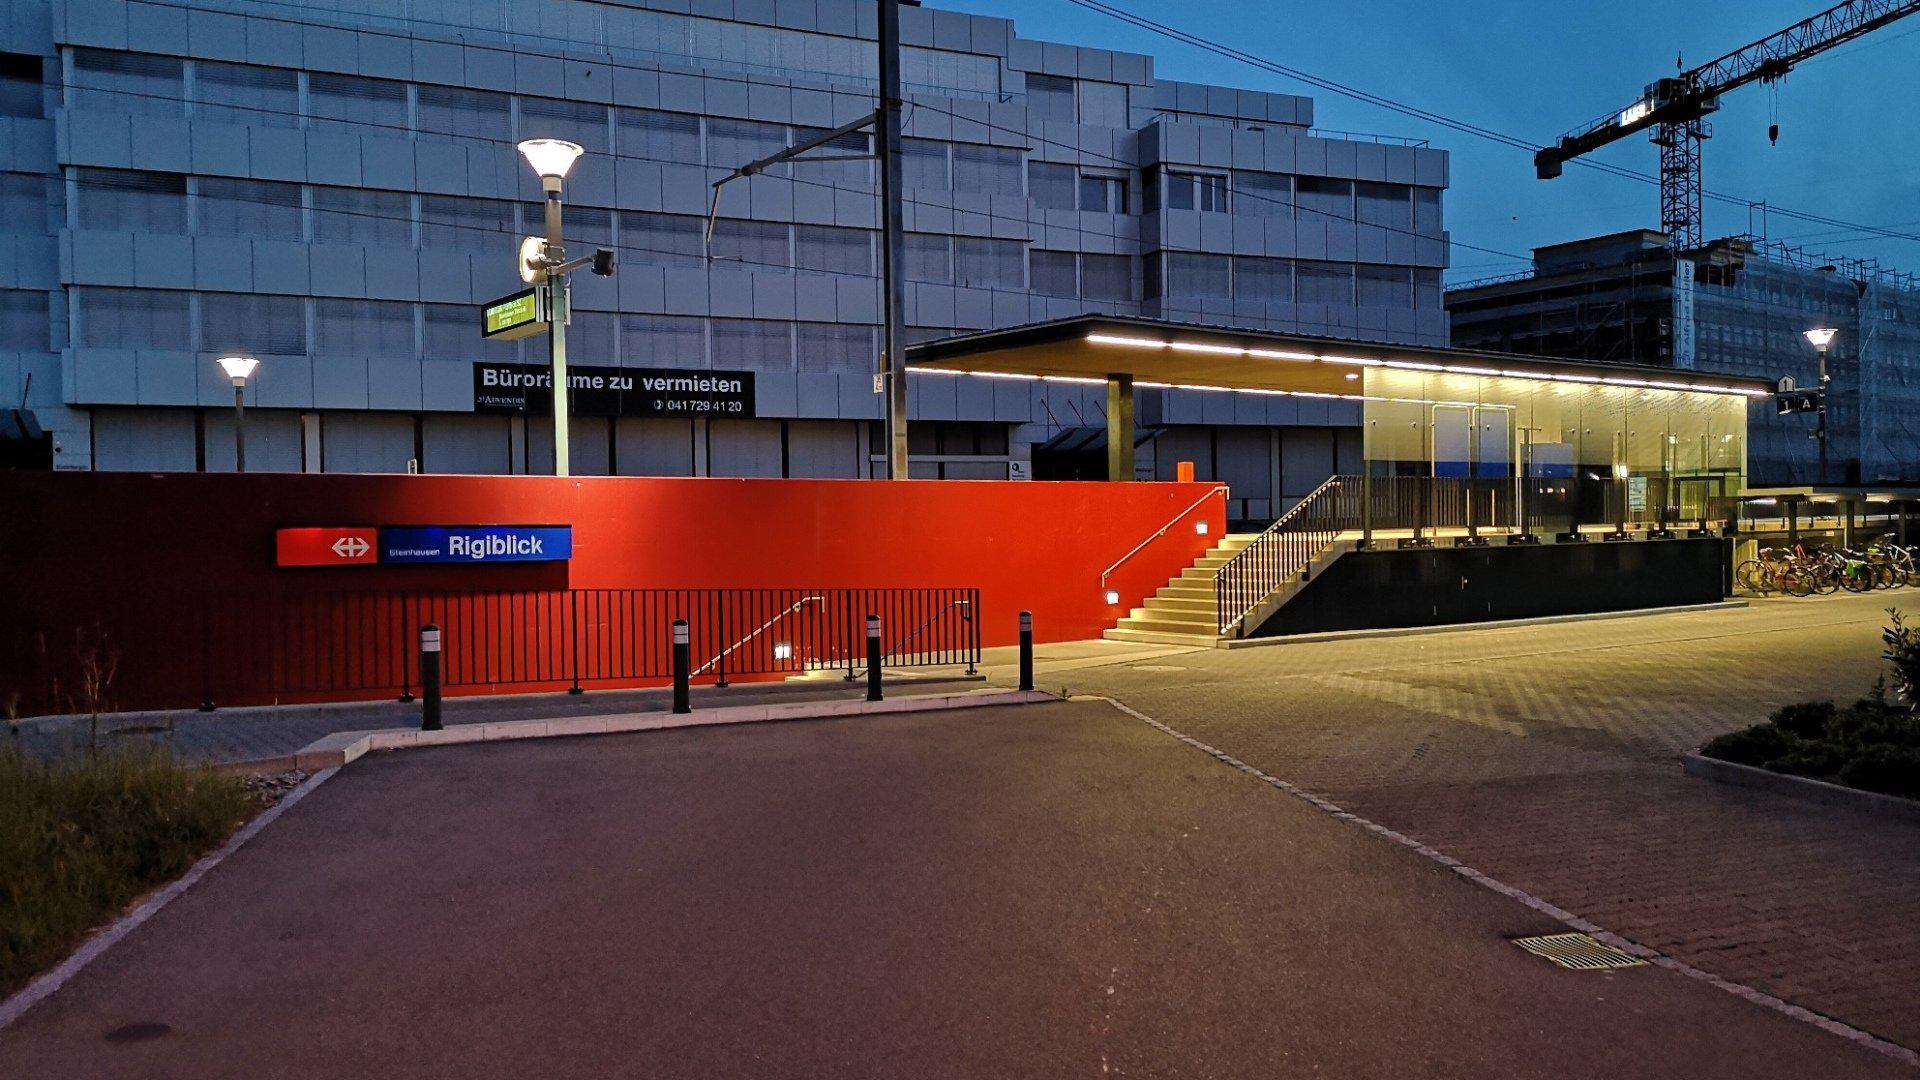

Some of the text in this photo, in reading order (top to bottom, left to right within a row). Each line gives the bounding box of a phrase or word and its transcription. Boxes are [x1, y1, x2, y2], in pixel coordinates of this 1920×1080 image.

[609, 377, 633, 390] zu
[642, 375, 742, 392] vermieten
[1783, 379, 1788, 392] 1
[667, 400, 742, 412] 041 729 41 20
[1802, 399, 1811, 409] A
[449, 535, 543, 559] Rigiblick
